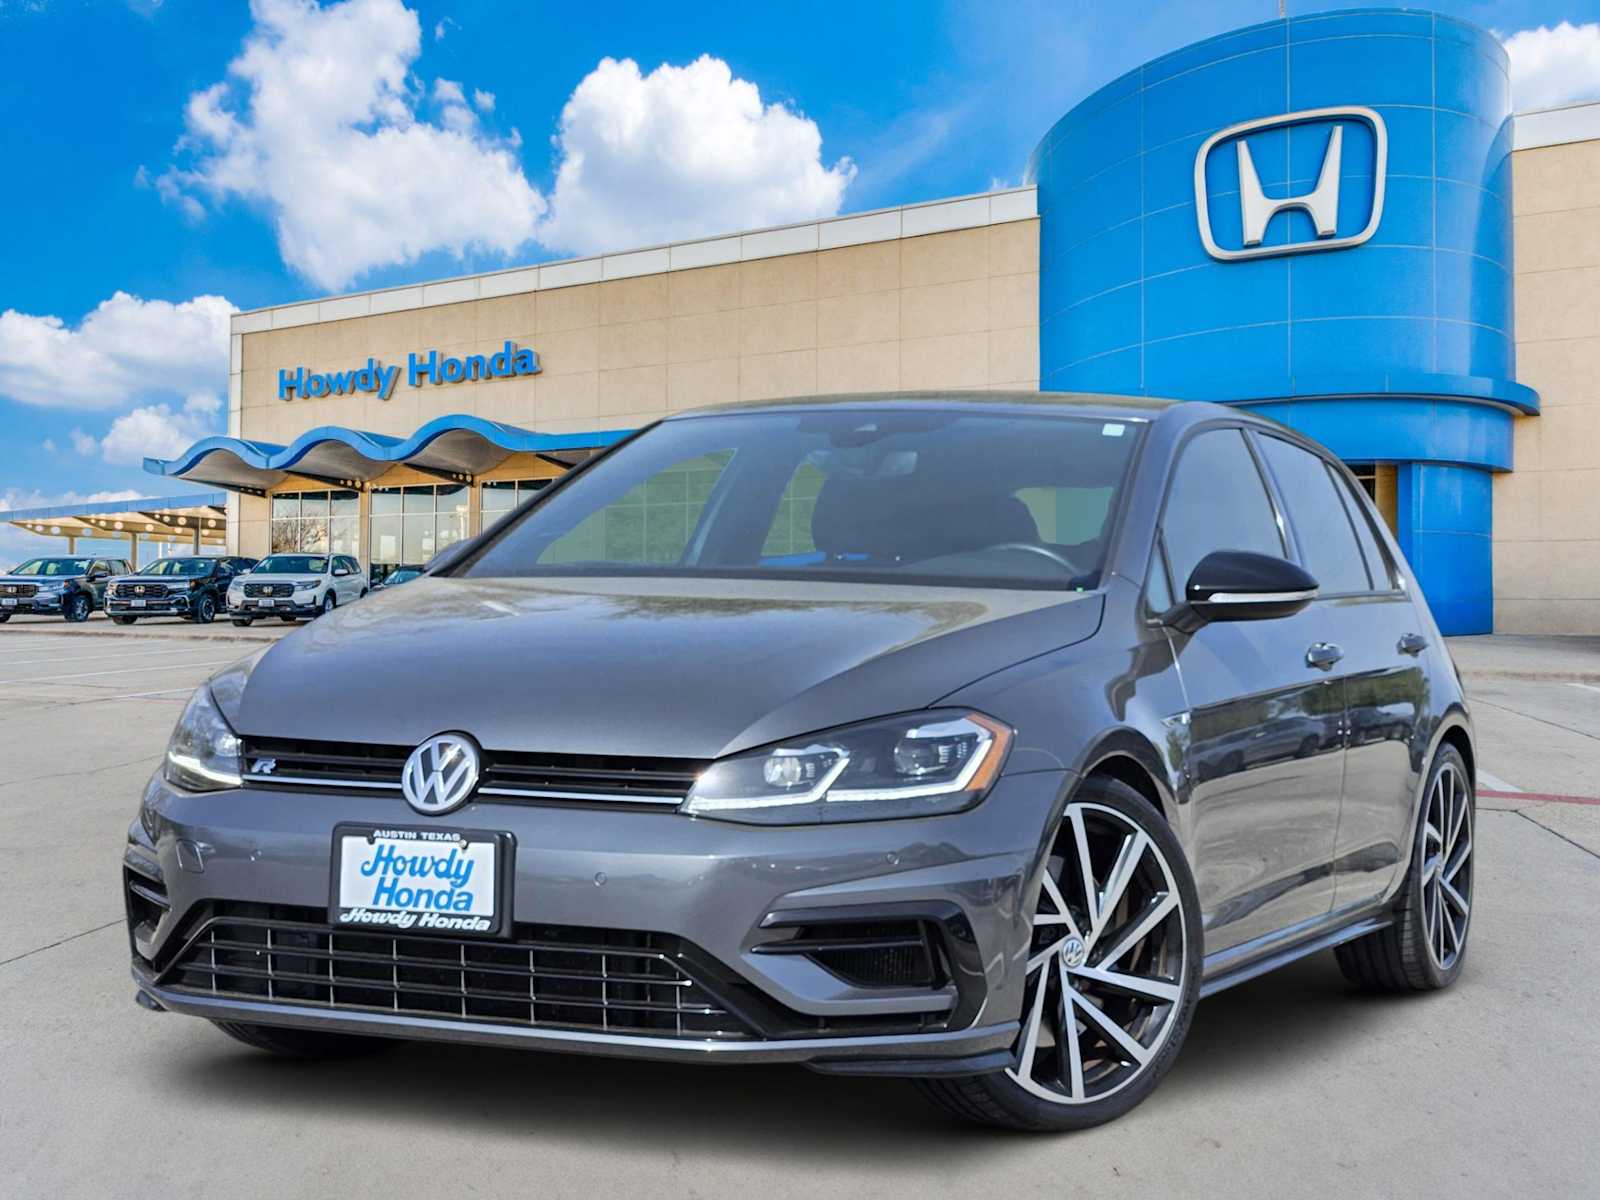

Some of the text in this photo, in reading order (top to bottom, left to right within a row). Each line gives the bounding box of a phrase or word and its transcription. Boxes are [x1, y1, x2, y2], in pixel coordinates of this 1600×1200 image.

[278, 340, 541, 401] Howdy Honda
[374, 829, 462, 842] AUSTIN TEXAS
[360, 844, 475, 888] Howdy
[372, 876, 474, 911] Honda
[340, 907, 491, 931] Howdy Honda
